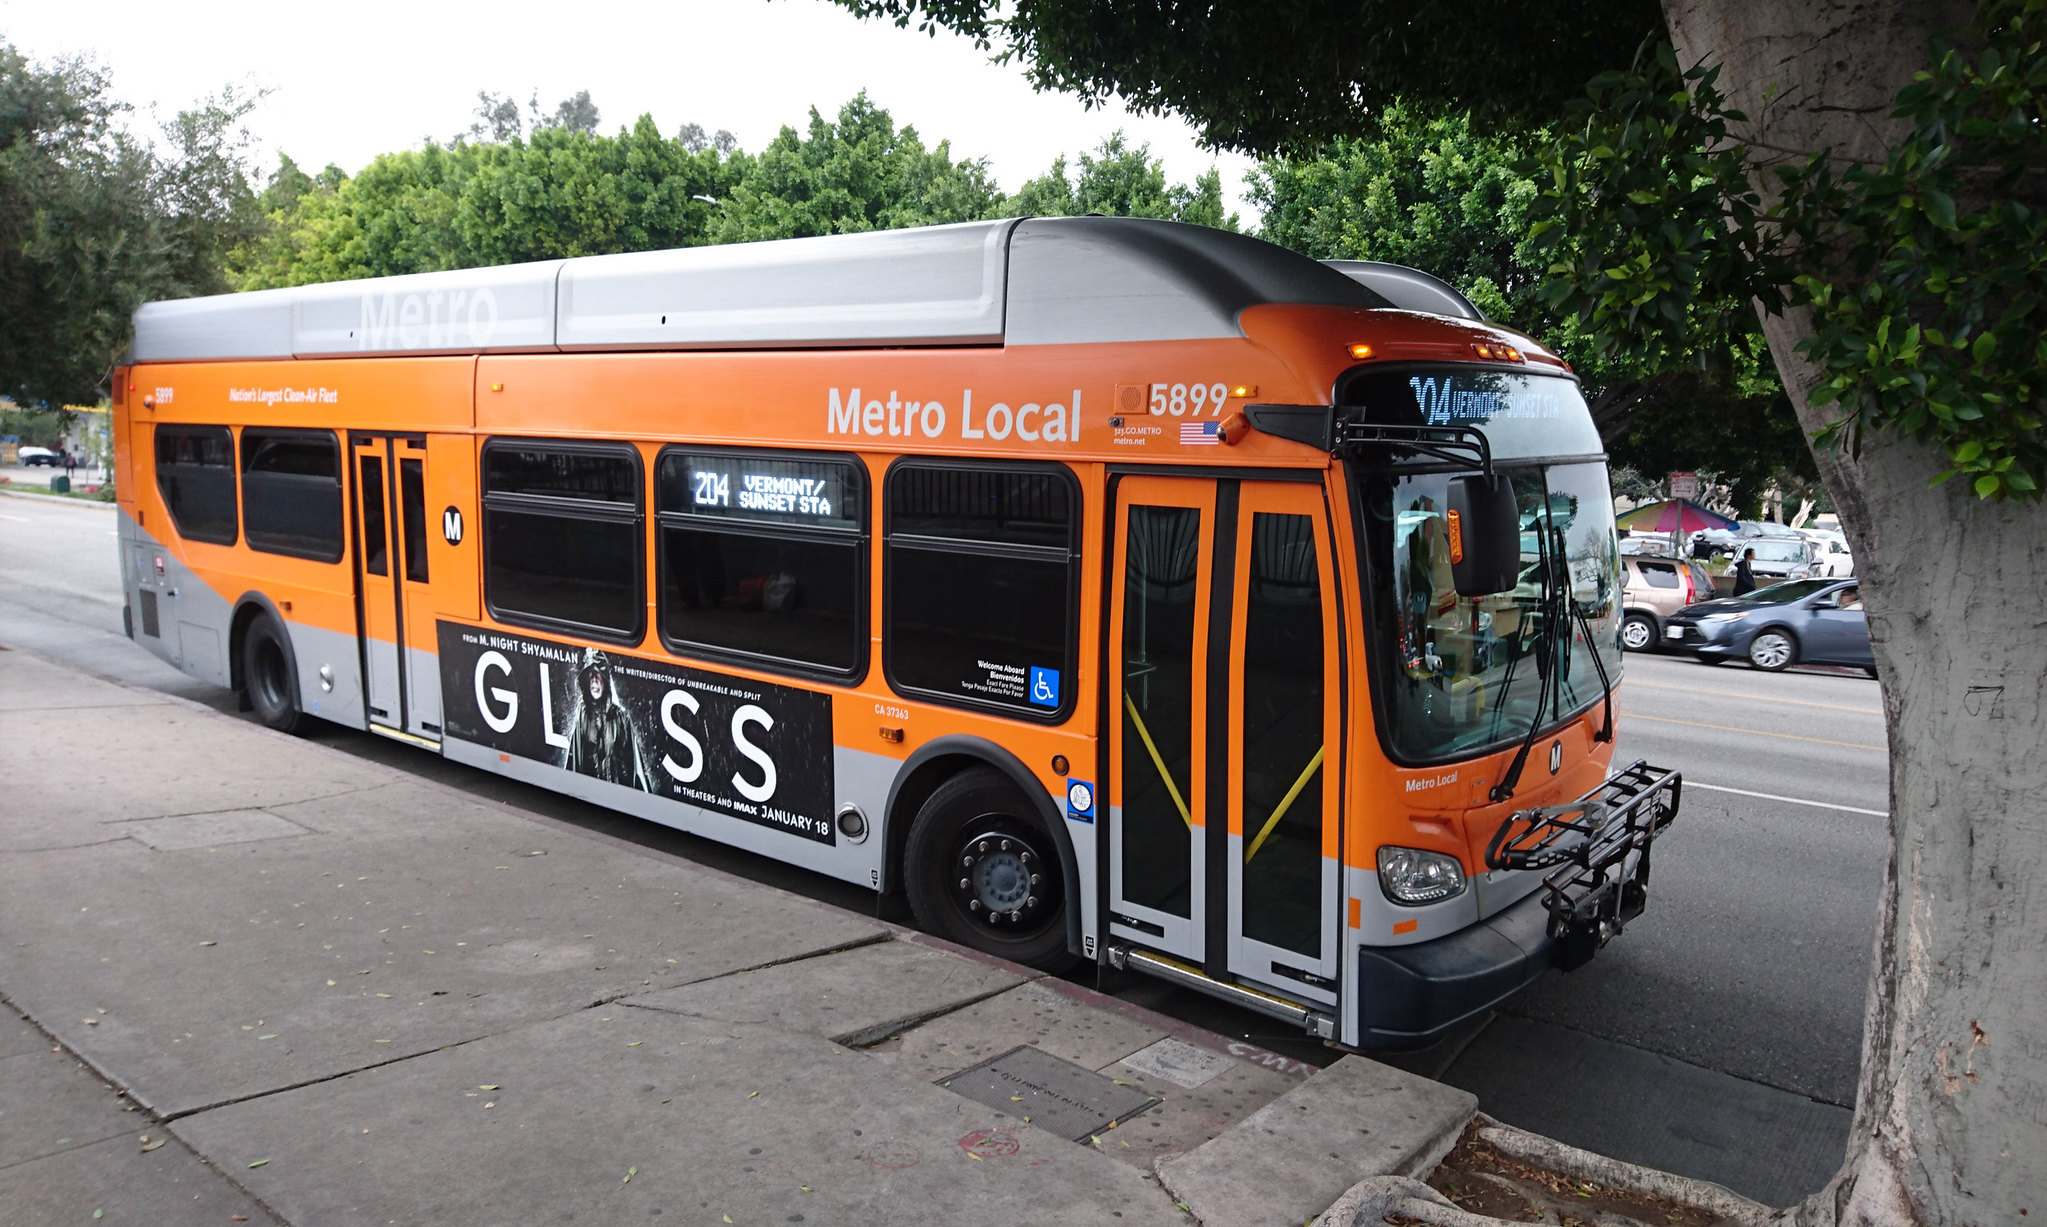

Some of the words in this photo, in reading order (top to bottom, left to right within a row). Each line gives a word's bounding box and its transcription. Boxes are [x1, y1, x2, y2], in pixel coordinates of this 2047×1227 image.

[359, 287, 498, 351] Metro
[155, 387, 174, 404] 5899
[229, 388, 256, 402] Nation's
[257, 388, 283, 406] Largest
[284, 387, 317, 403] Clean-Air
[319, 388, 338, 403] Fleet
[1150, 383, 1227, 417] 5899
[828, 387, 946, 438] Metro
[961, 389, 1081, 442] Local
[1113, 437, 1146, 446] metro.net
[1114, 427, 1162, 436] 323.GO.METRO
[695, 471, 729, 506] 204
[744, 475, 826, 497] VERMONT/
[740, 491, 796, 513] SUNSET
[799, 495, 831, 516] STA
[445, 511, 461, 541] M
[462, 633, 478, 643] FROM
[479, 634, 489, 647] M.
[490, 636, 518, 652] NIGHT
[521, 641, 578, 665] SHYAMALAN
[977, 660, 1004, 671] Welcome
[1004, 665, 1025, 675] Aboard
[990, 670, 1024, 684] Bienvenidos
[614, 665, 625, 674] THE
[677, 677, 686, 686] OF
[687, 680, 728, 695] UNBREAKABLE
[730, 689, 743, 698] AND
[744, 692, 761, 701] SPLIT
[874, 703, 885, 715] CA
[886, 706, 909, 720] 37363
[474, 650, 777, 803] GLSS
[1550, 745, 1562, 770] M
[1405, 778, 1435, 792] Metro
[1436, 771, 1458, 786] Local
[673, 784, 682, 793] IN
[683, 786, 716, 804] THEATERS
[717, 797, 732, 808] AND
[733, 803, 758, 816] IMAX
[761, 805, 813, 831] JANUARY
[815, 821, 829, 836] 18
